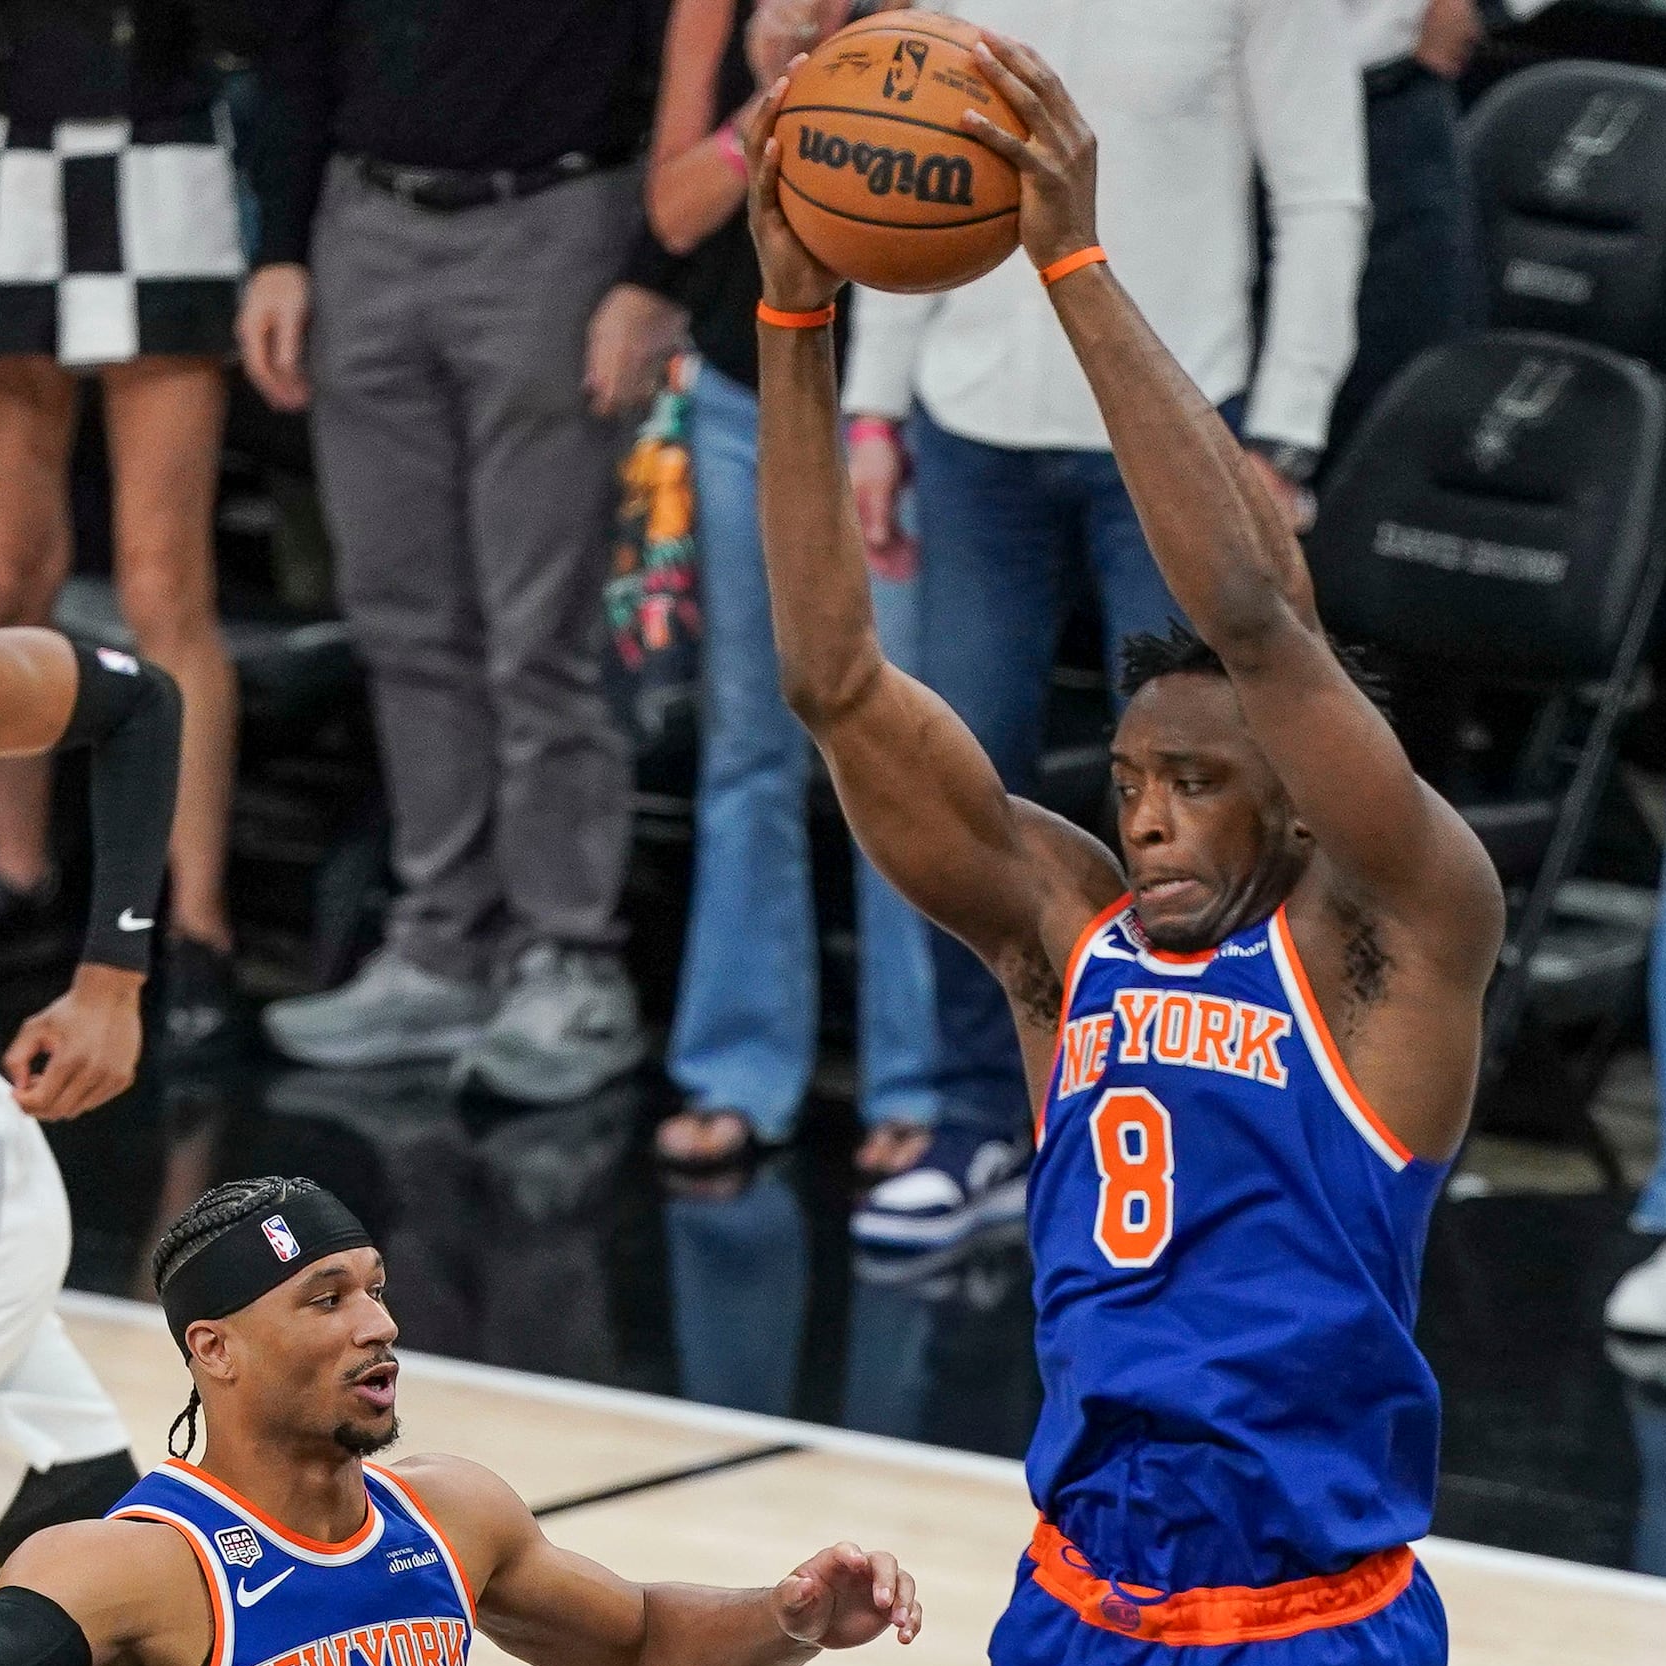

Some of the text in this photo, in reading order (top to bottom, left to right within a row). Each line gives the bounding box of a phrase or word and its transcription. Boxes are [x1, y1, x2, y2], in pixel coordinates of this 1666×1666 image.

[797, 124, 974, 207] Wilson
[1058, 986, 1294, 1100] NE YORK
[1088, 1086, 1175, 1268] 8
[220, 1531, 252, 1545] USA
[226, 1545, 260, 1561] 250
